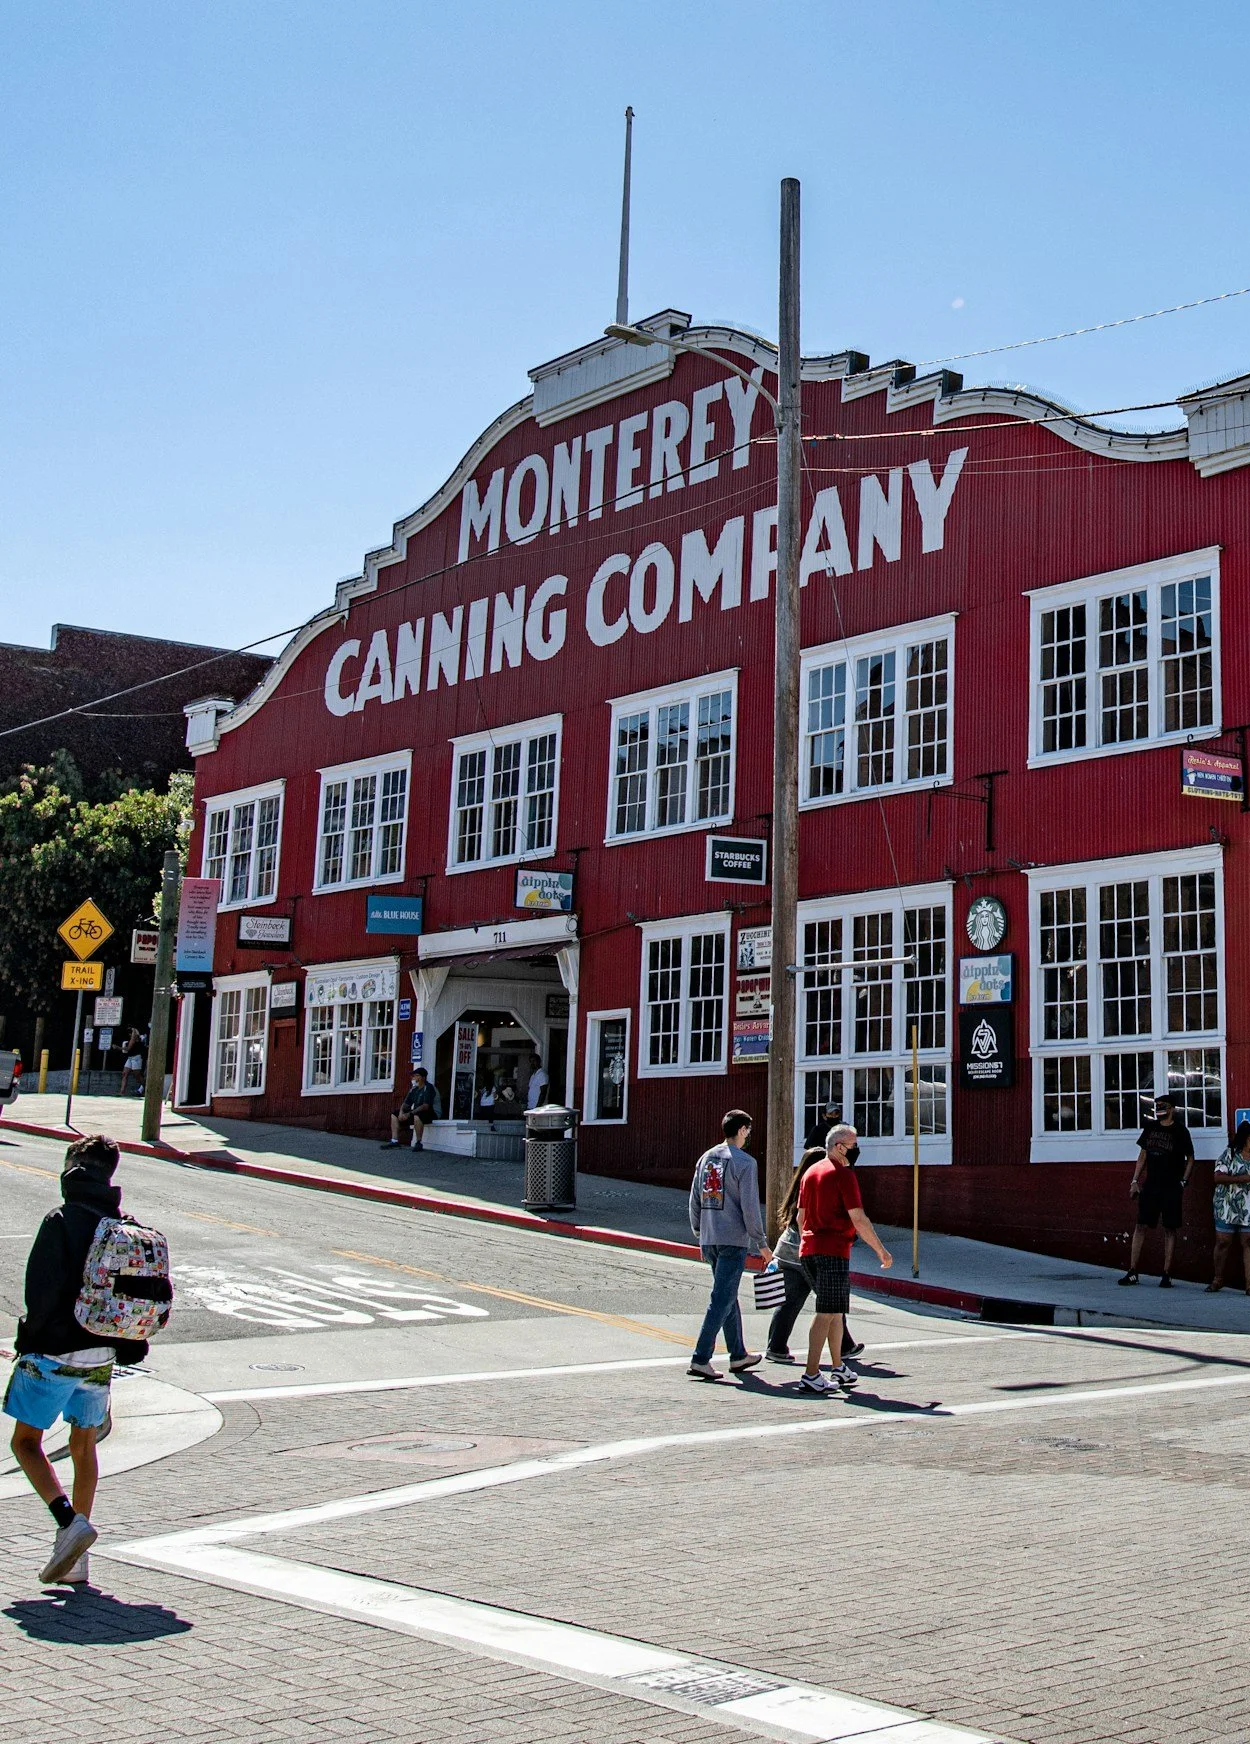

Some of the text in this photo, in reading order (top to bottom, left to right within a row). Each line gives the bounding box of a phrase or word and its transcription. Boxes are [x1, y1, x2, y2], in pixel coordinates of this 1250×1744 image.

[458, 366, 764, 565] MONTEREY
[324, 446, 969, 718] CANNING COMPANY
[714, 851, 761, 862] STARBUCKS
[723, 860, 752, 869] COFFEE
[538, 887, 566, 900] dots
[383, 910, 399, 920] BLUE
[400, 911, 420, 920] HOUSE
[246, 918, 285, 930] Steinbeck
[493, 932, 506, 944] 711
[71, 966, 95, 974] TRAIL
[980, 978, 1006, 991] dots
[458, 1027, 475, 1042] SALE
[458, 1050, 471, 1065] OFF
